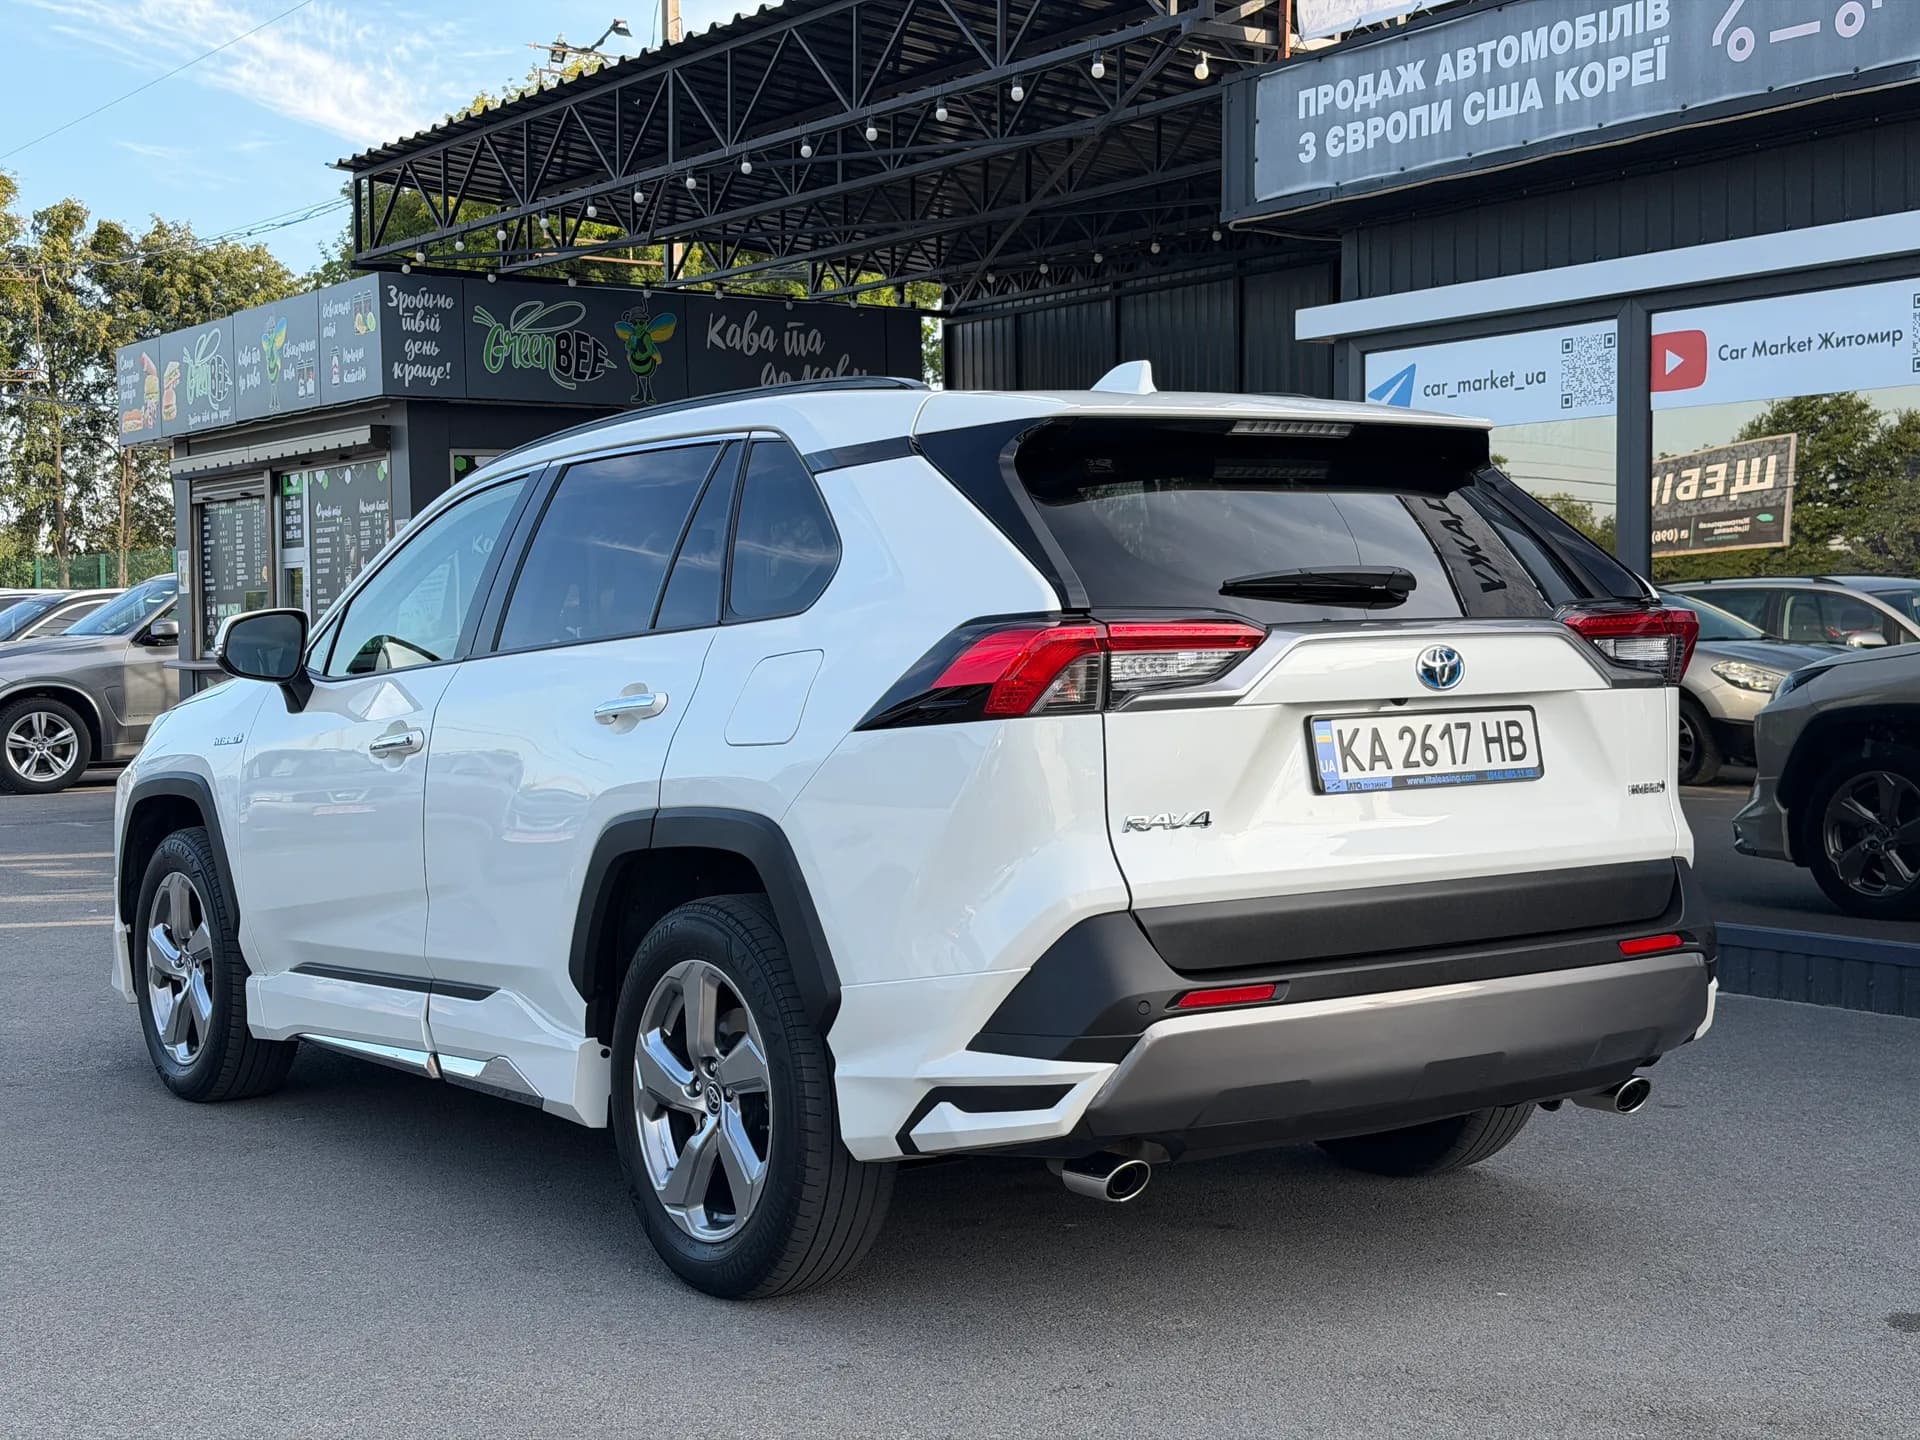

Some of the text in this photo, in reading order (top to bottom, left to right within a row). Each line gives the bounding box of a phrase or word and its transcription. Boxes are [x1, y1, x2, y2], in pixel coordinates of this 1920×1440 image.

[1298, 0, 1670, 119] ПРОДАЖ АВТОМОБІЛІВ
[1298, 35, 1670, 163] З ЄВРОПИ США КОРЕЇ
[387, 285, 454, 315] Зробимо
[402, 309, 441, 332] твій
[706, 310, 825, 357] Кава та
[404, 338, 440, 361] день
[1718, 329, 1904, 361] Car Market Житомир
[392, 362, 451, 387] краще!
[1423, 370, 1546, 398] car_market_ua
[1337, 719, 1527, 773] KA 2617 HB
[1320, 759, 1337, 774] UA
[1122, 810, 1213, 834] RAV4
